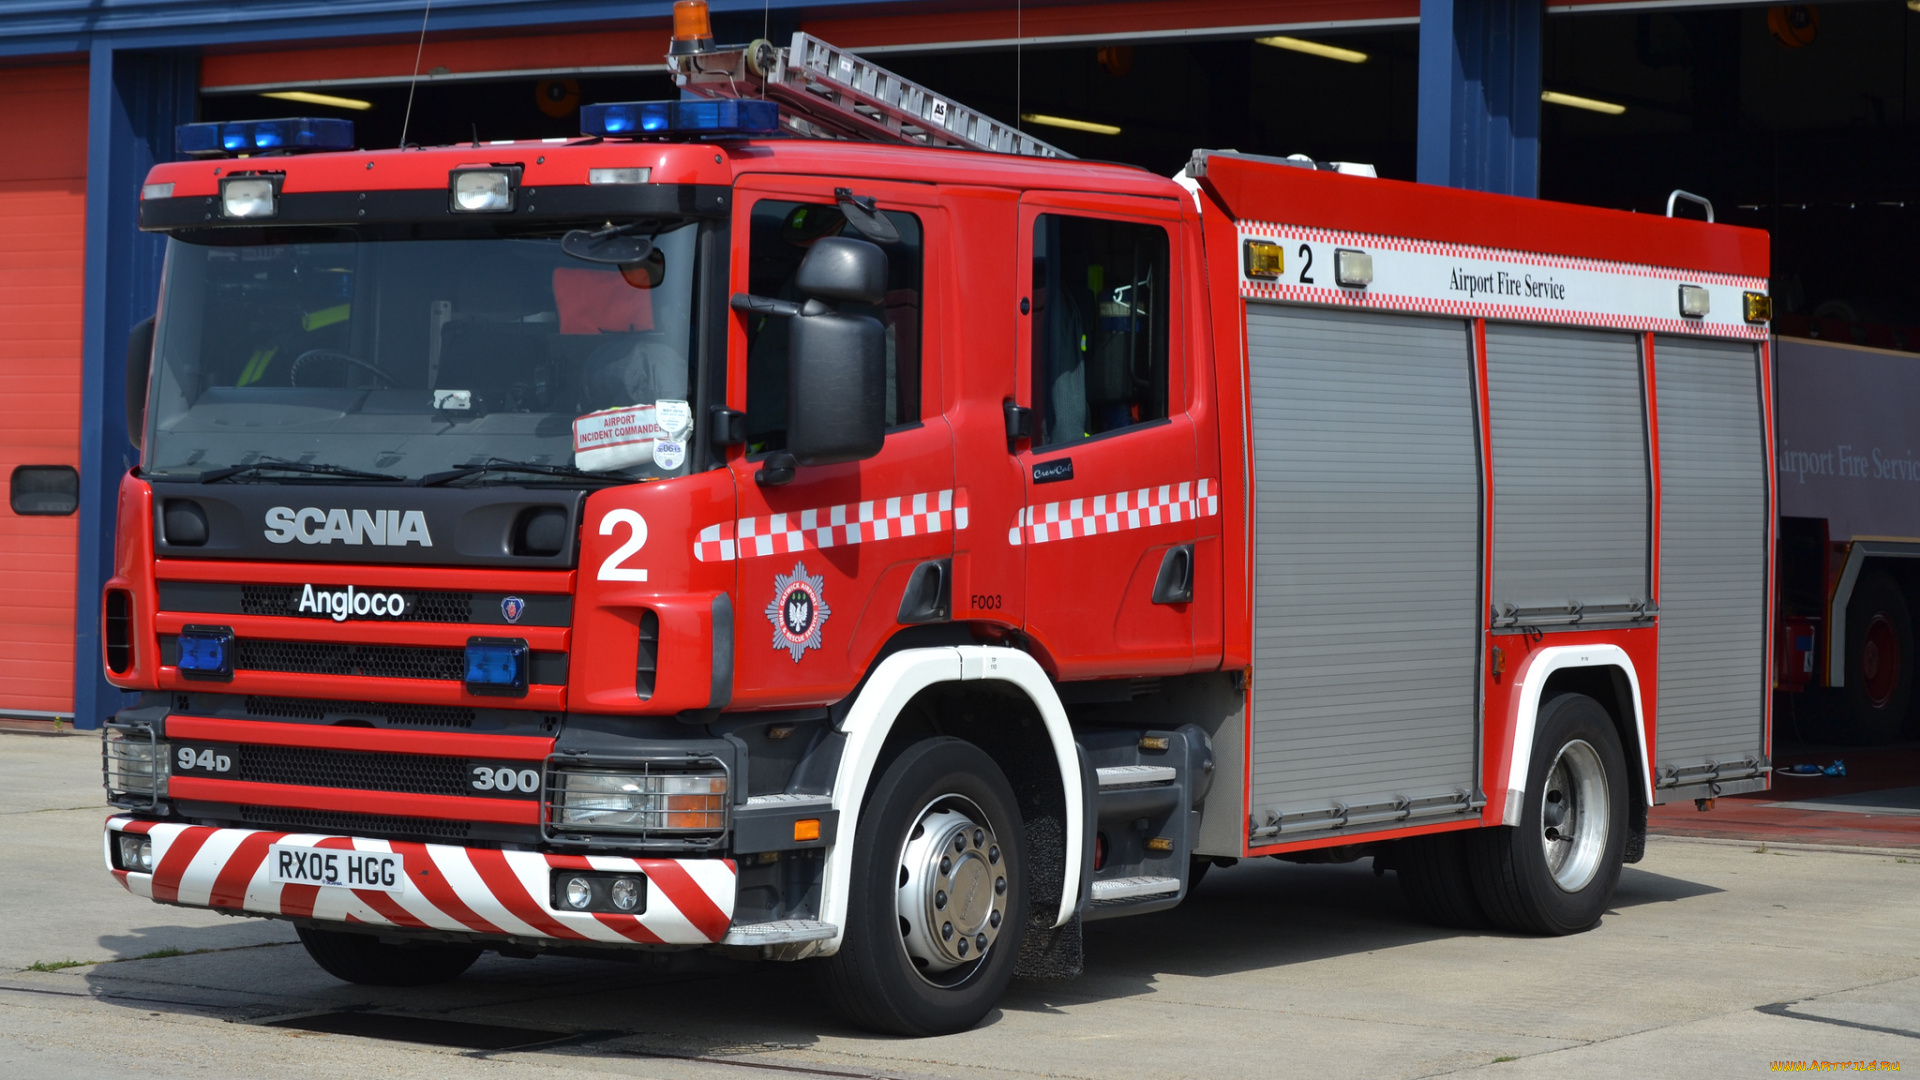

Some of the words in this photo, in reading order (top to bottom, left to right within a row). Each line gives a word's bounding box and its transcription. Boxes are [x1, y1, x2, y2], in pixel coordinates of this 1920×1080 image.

[934, 103, 945, 115] AS
[1298, 243, 1314, 284] 2
[1449, 266, 1494, 298] Airport
[1497, 271, 1521, 296] Fire
[1524, 274, 1565, 300] Service
[579, 429, 613, 443] INCIDENT
[604, 414, 636, 428] AIRPORT
[1837, 444, 1869, 478] Fire
[264, 506, 433, 547] SCANIA
[596, 508, 648, 582] 2
[298, 583, 405, 622] Angloco
[780, 582, 800, 606] GATWICK
[801, 582, 818, 606] AIRPORT
[786, 633, 805, 642] RESCUE
[805, 611, 818, 637] SERVICE
[177, 747, 231, 772] 94D
[472, 766, 540, 793] 300
[278, 850, 338, 882] RX05
[347, 855, 395, 886] HGG
